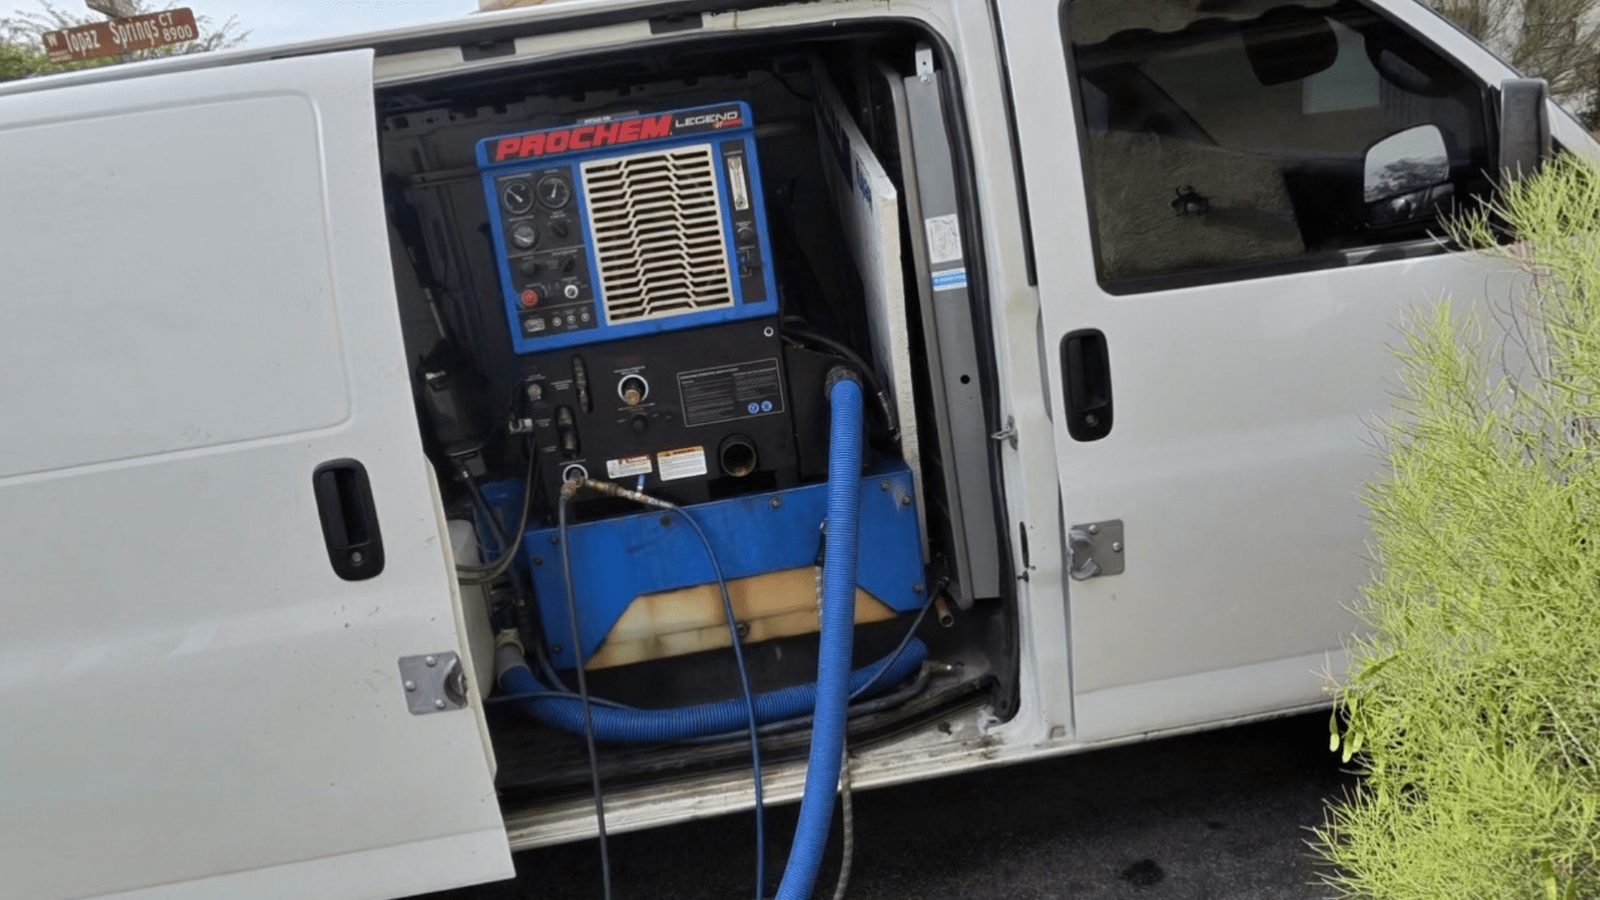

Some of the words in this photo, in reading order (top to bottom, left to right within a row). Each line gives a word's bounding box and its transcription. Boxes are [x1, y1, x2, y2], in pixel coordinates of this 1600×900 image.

[47, 34, 58, 47] W
[62, 29, 101, 56] Topaz
[109, 19, 159, 46] Springs
[159, 12, 173, 26] CT
[163, 25, 193, 42] 8900
[496, 114, 673, 161] PROCHEM
[675, 111, 738, 128] LEGEND
